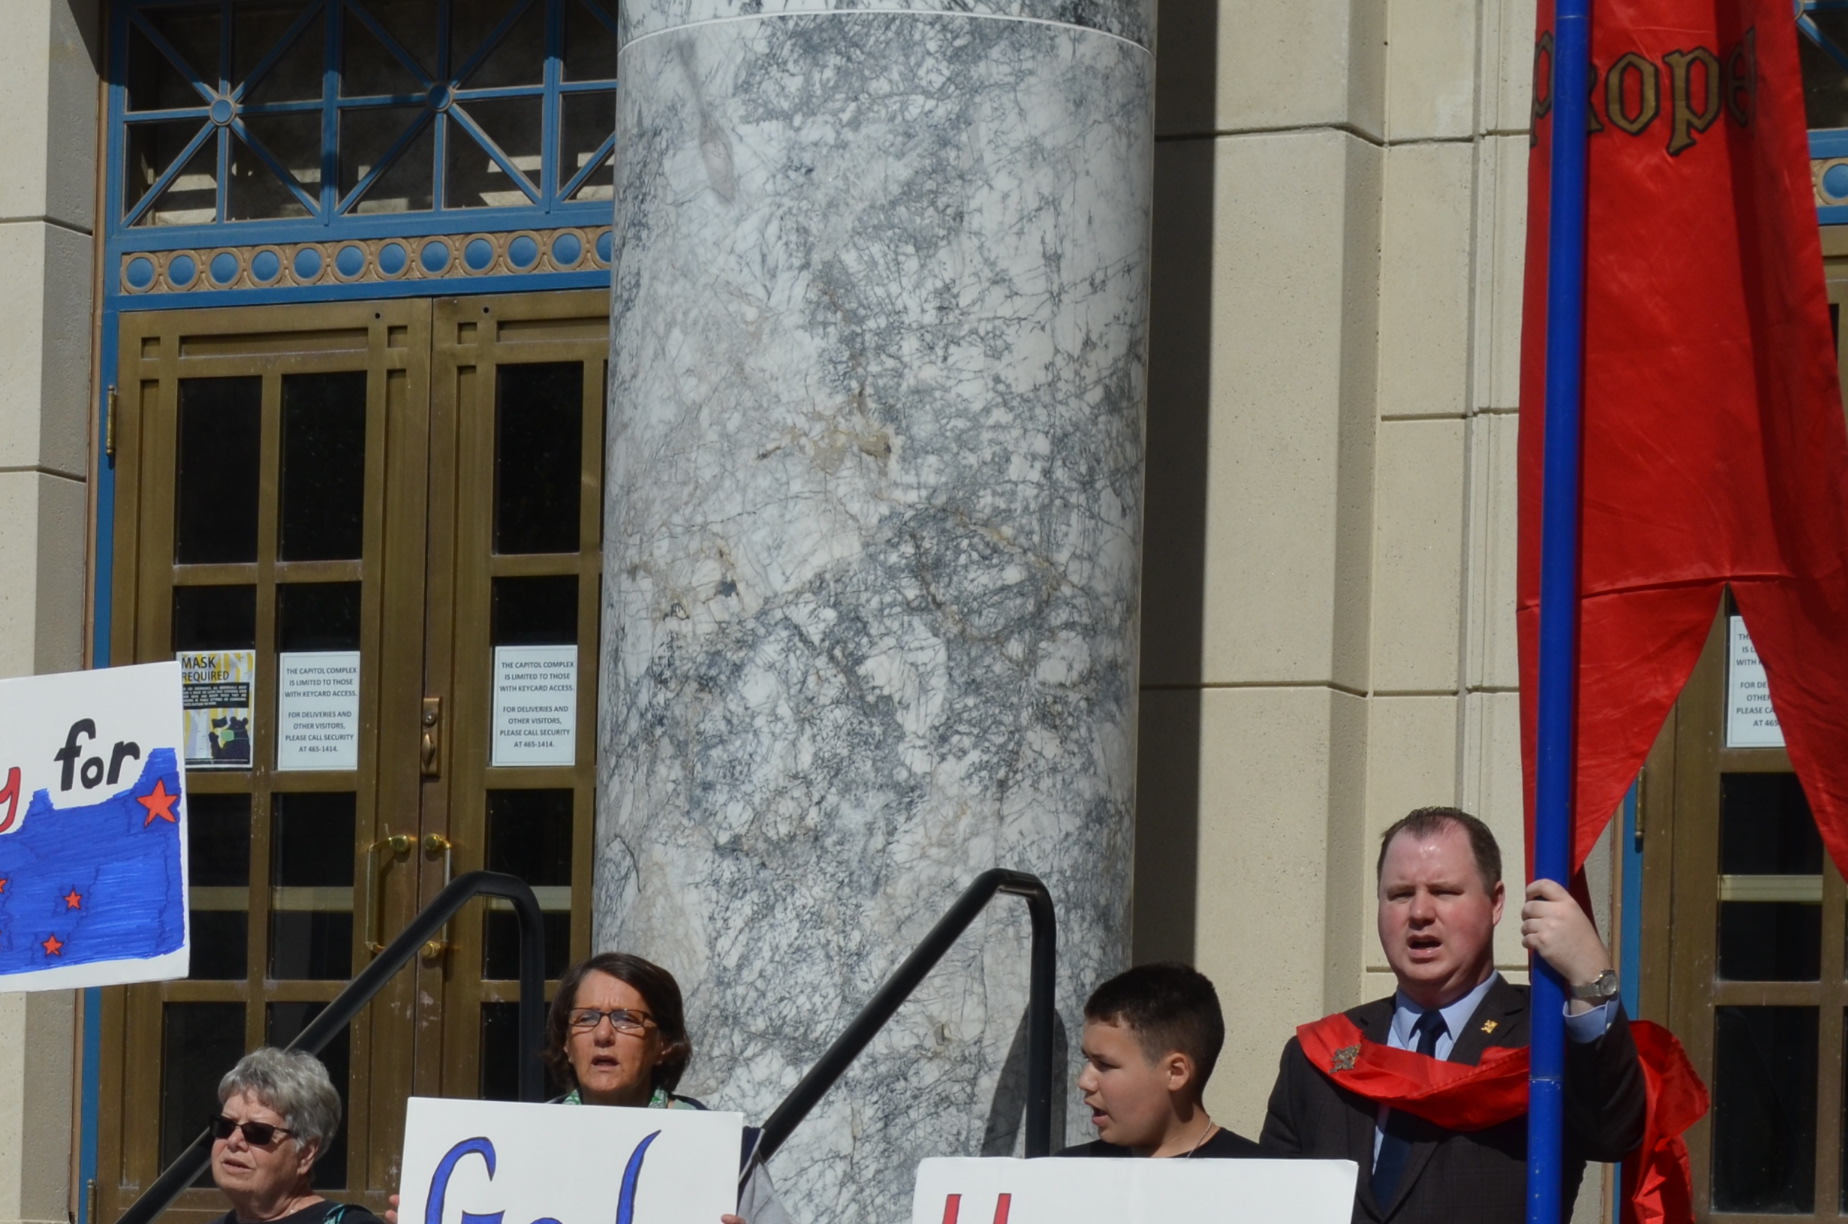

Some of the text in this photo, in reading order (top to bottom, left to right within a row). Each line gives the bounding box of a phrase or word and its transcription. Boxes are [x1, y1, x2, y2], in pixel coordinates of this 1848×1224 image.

[182, 657, 215, 668] MASK
[182, 671, 229, 681] REQUIRED
[53, 718, 140, 792] for
